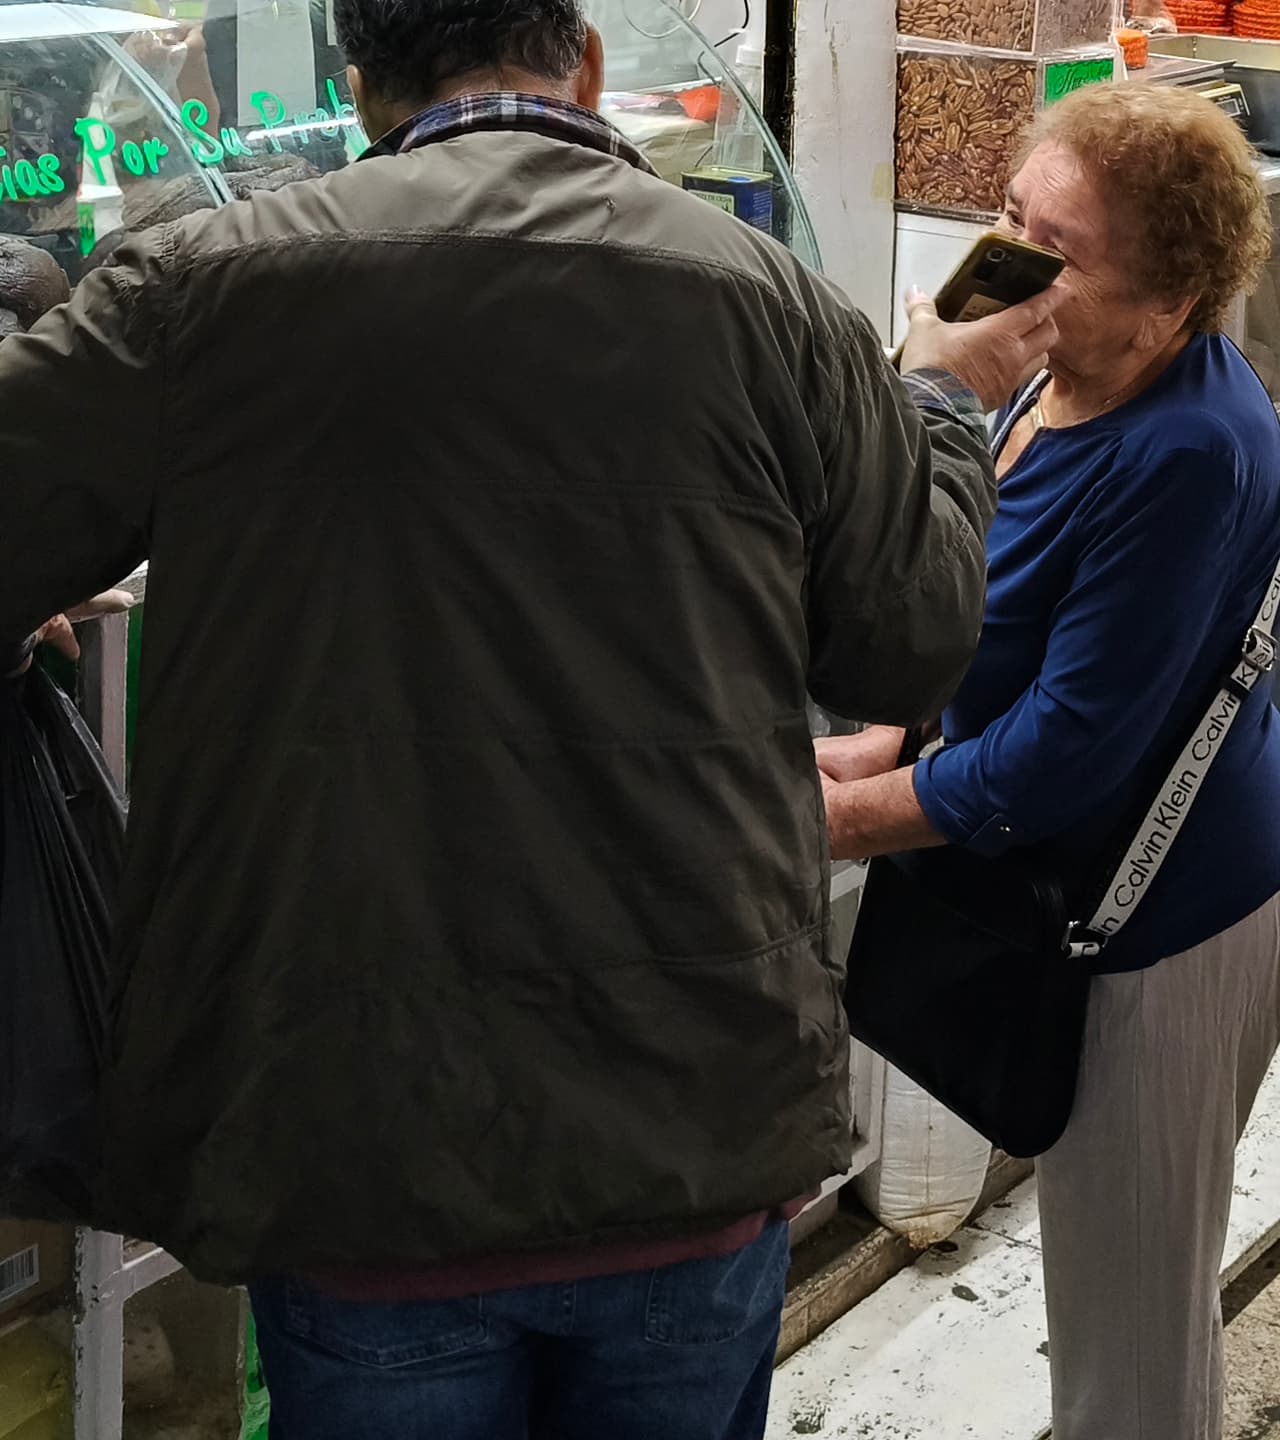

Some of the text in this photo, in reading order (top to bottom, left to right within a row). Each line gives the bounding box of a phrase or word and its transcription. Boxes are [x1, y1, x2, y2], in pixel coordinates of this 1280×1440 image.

[73, 116, 170, 186] Por
[180, 98, 254, 164] Su
[1114, 768, 1199, 909] Calvin Klein
